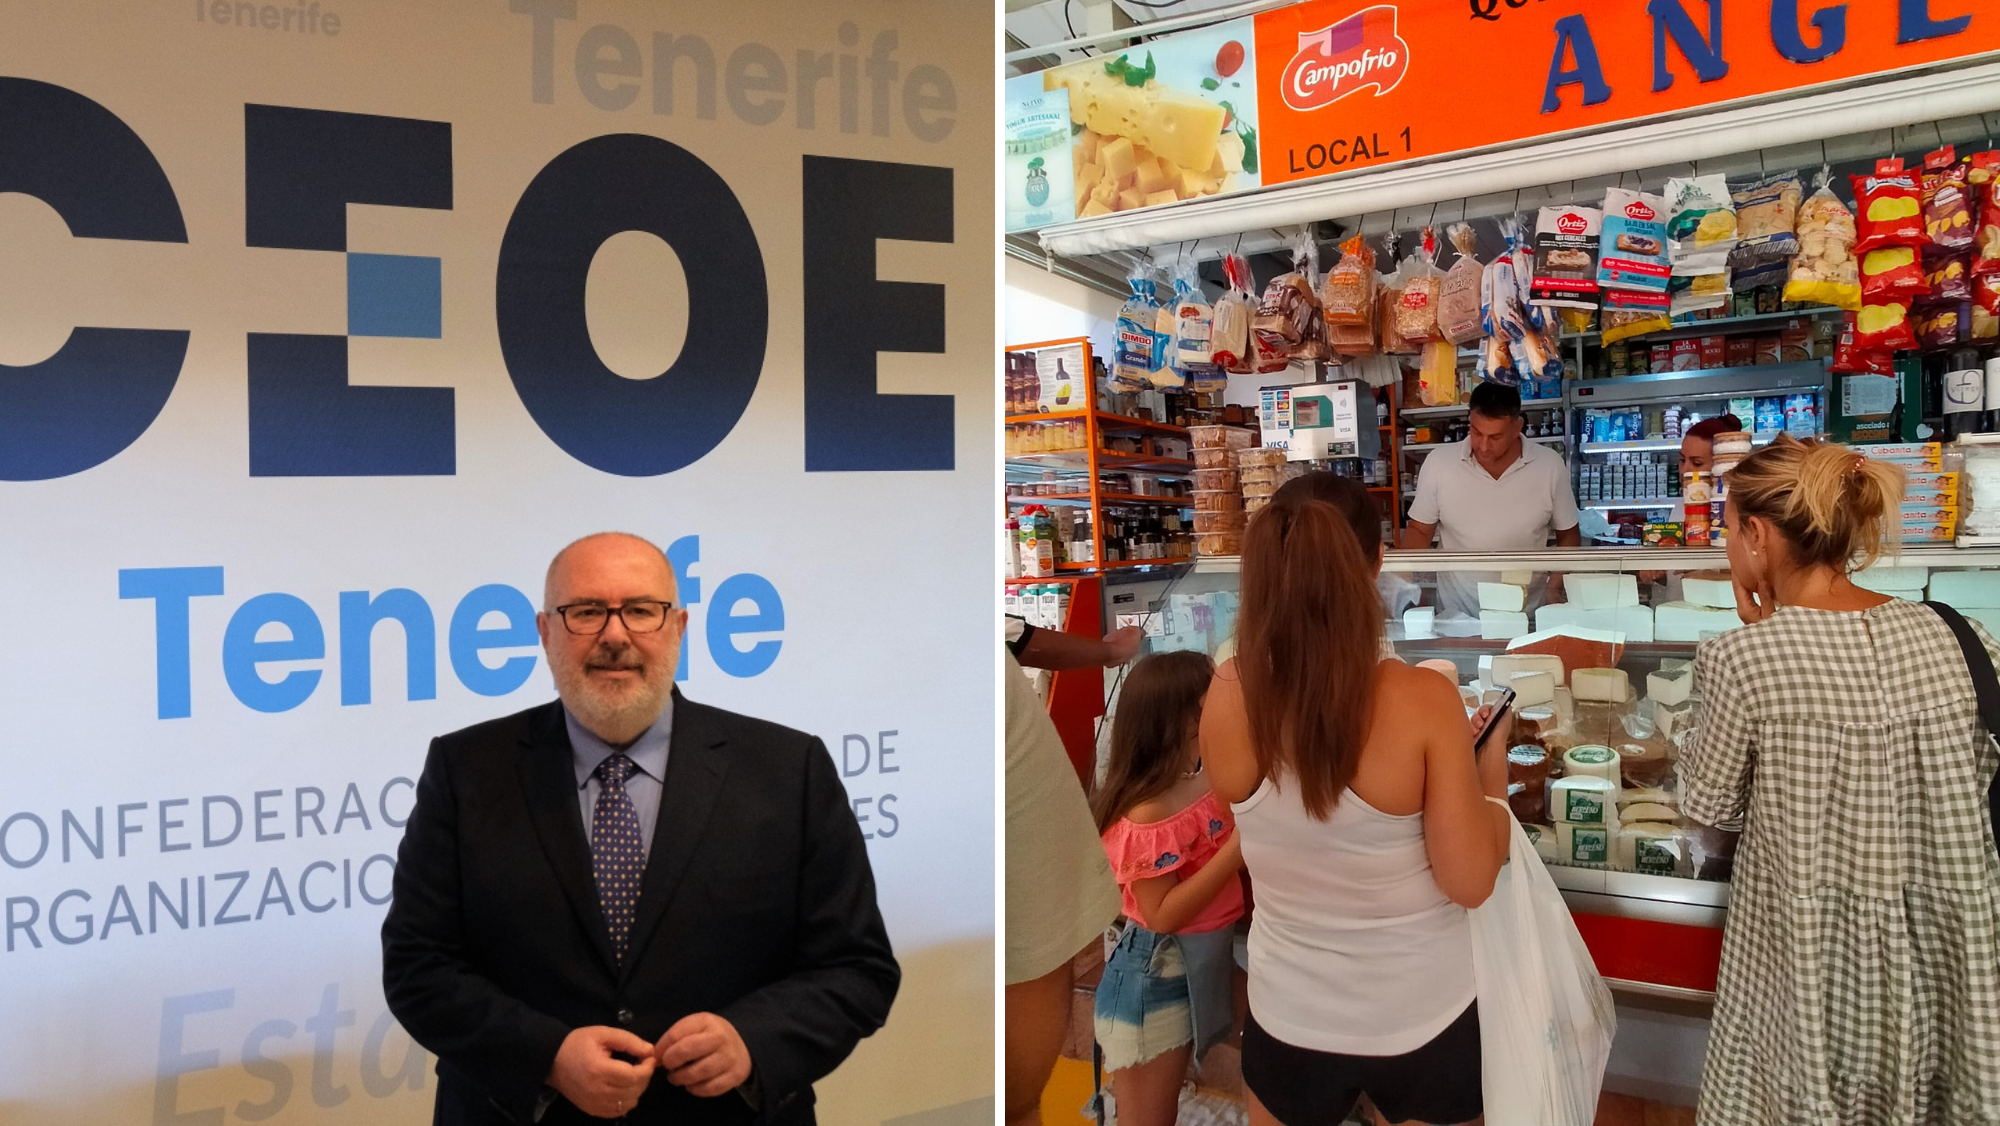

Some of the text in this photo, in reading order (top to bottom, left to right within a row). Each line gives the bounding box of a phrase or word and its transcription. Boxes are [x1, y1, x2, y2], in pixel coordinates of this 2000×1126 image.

[508, 0, 958, 144] Tenerife
[1289, 126, 1411, 174] LOCAL 1
[1625, 205, 1654, 218] Ortiz
[1558, 217, 1587, 230] Ortiz
[1451, 323, 1473, 334] BIMBO
[1121, 332, 1152, 346] BIMBO
[1856, 421, 1886, 430] asociado
[1266, 440, 1289, 450] VISA
[118, 534, 786, 720] Tenefe
[843, 730, 900, 778] DE
